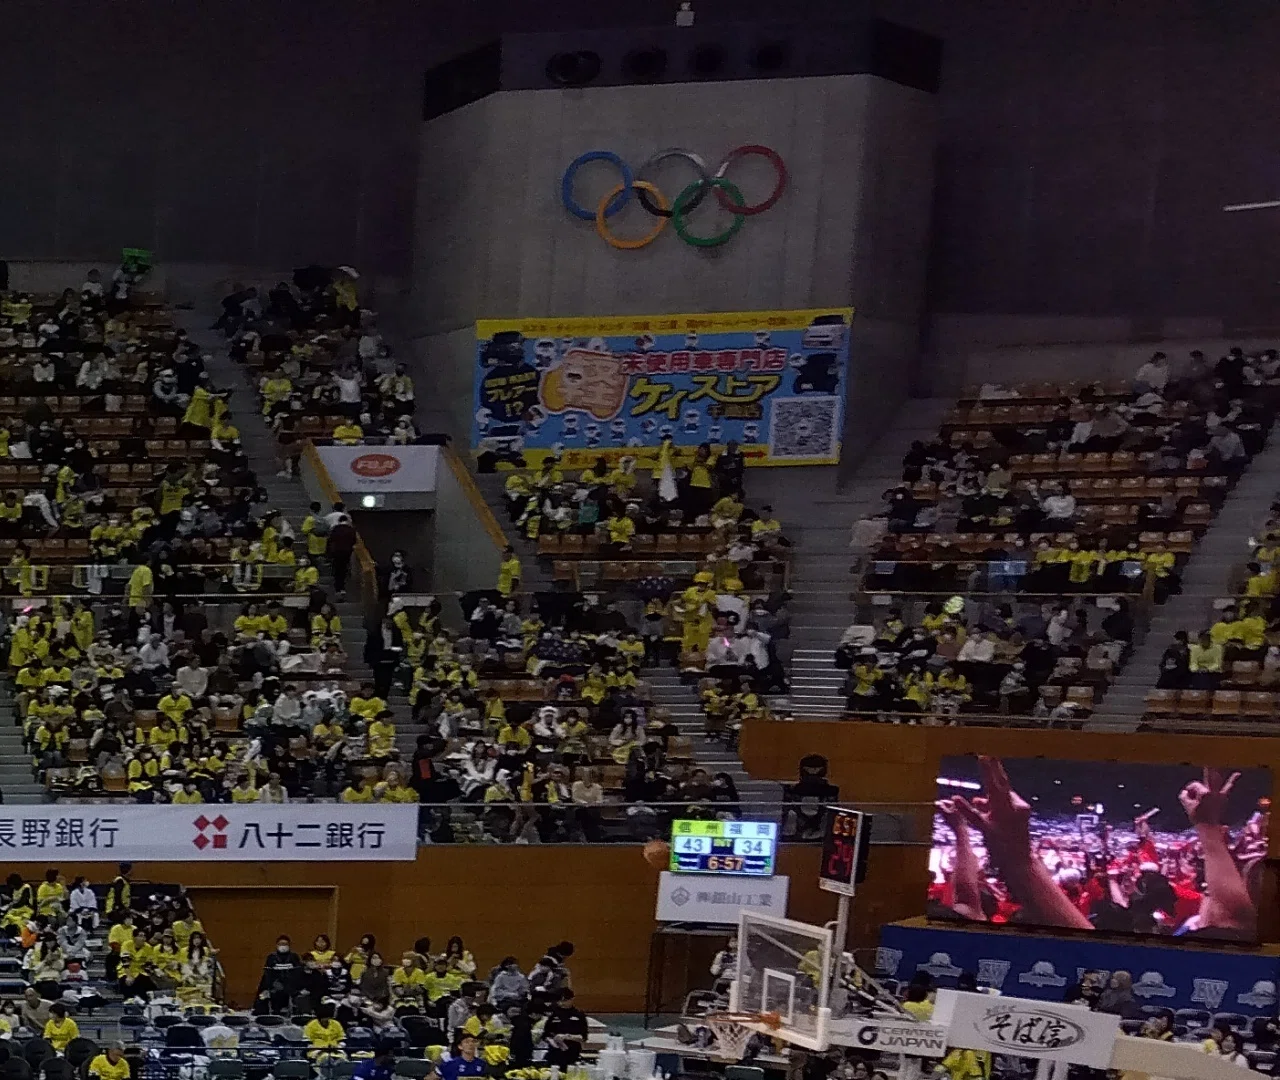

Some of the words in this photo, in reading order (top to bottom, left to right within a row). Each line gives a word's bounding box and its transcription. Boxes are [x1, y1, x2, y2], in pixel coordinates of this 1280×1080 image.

[239, 822, 386, 849] 八十二銀行
[683, 838, 703, 852] 43
[741, 840, 762, 854] 34
[707, 857, 744, 870] 6:57
[882, 1026, 944, 1038] CERATEC
[878, 1035, 944, 1050] JAPAN
